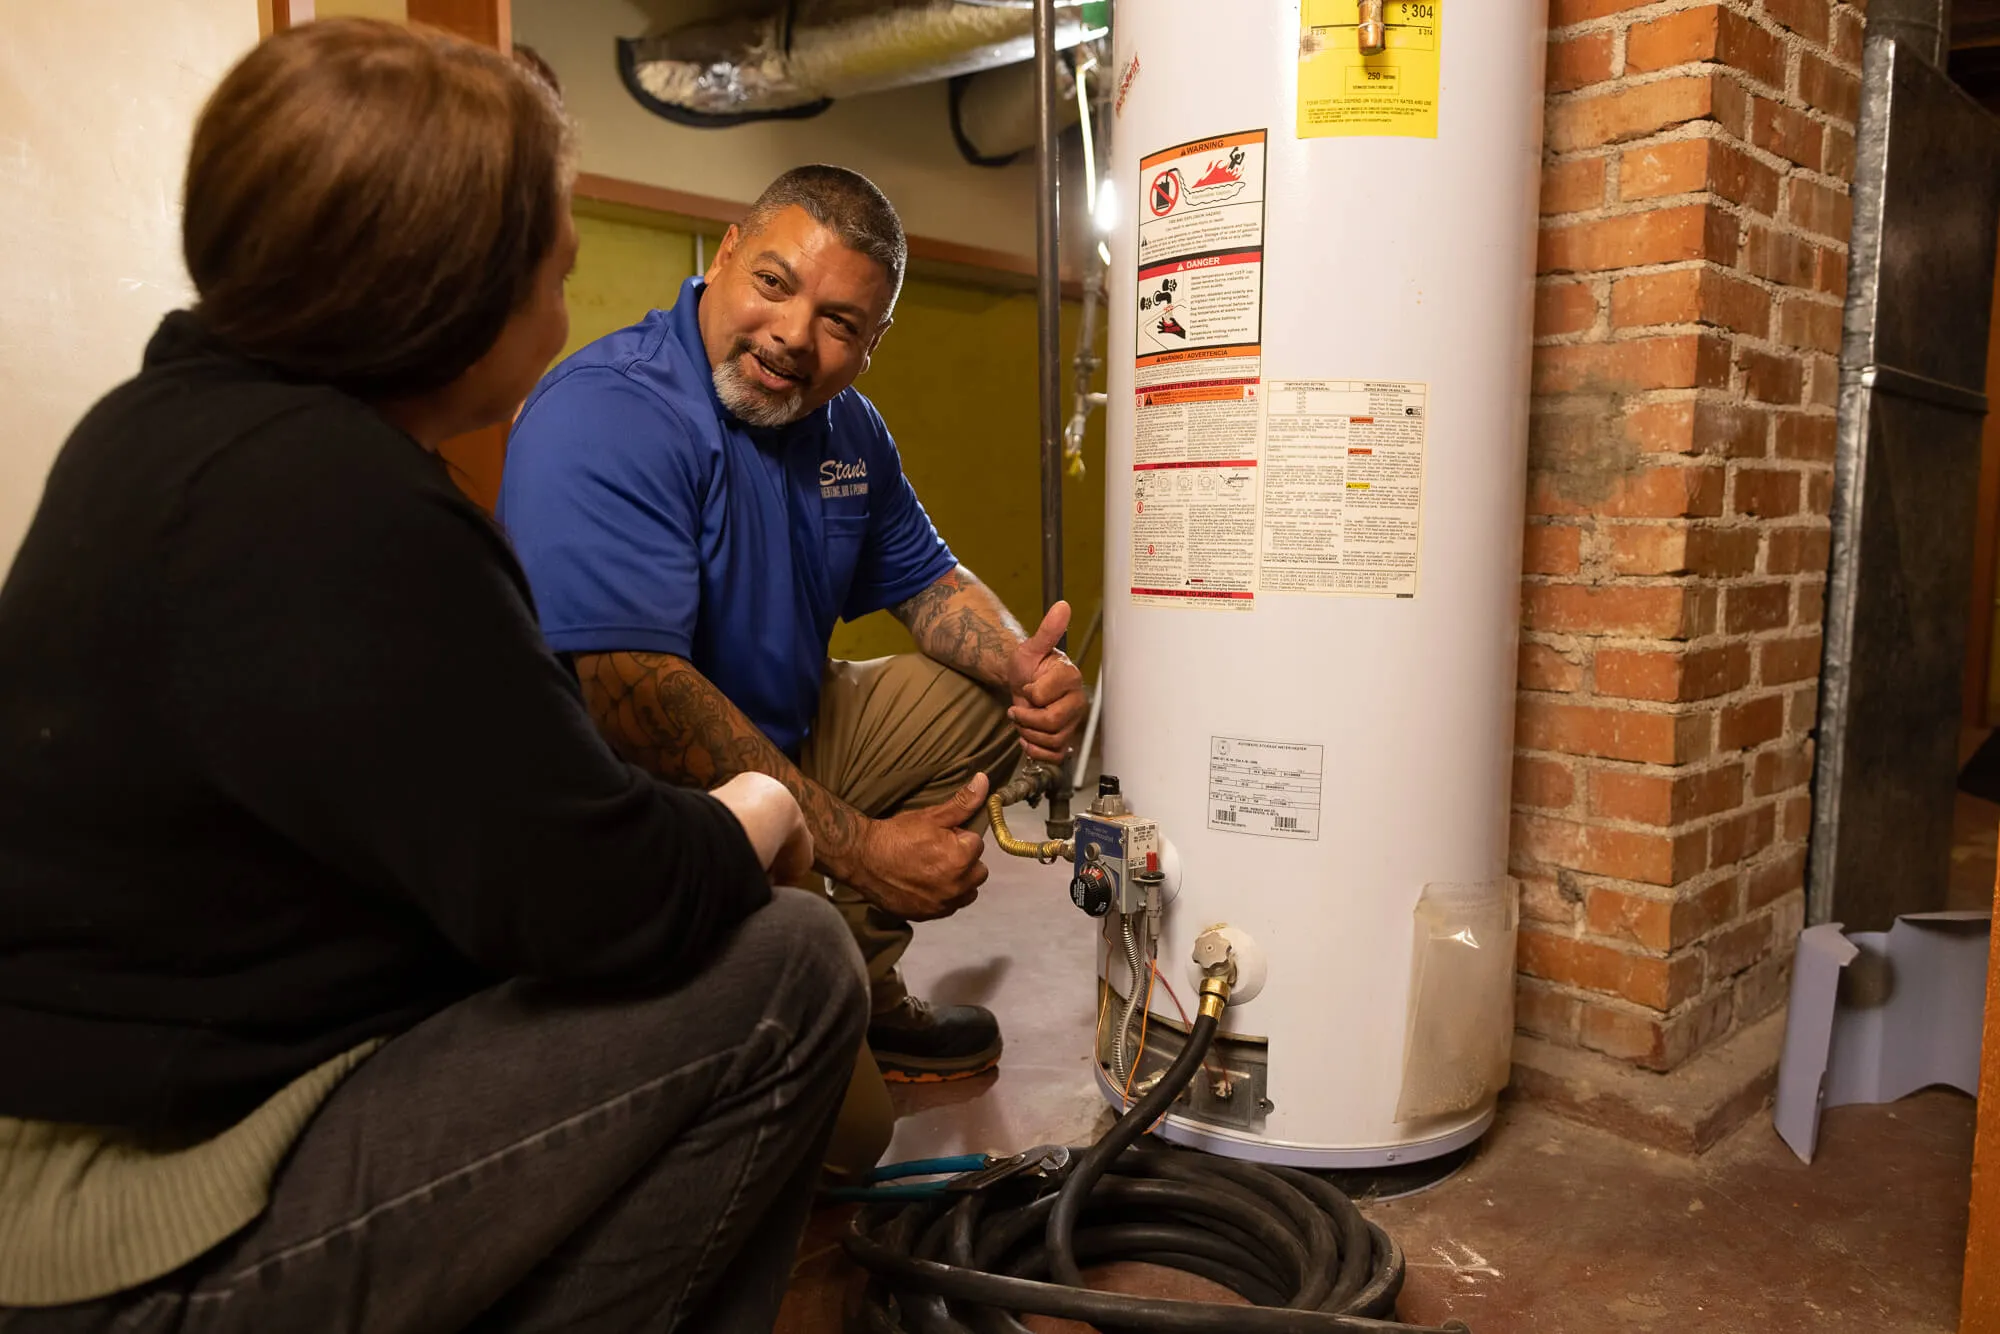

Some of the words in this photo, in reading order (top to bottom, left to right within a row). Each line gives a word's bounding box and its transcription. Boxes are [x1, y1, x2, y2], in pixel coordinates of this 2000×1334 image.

[1401, 3, 1408, 14] $
[1411, 3, 1433, 18] 304
[1367, 72, 1381, 80] 250
[1186, 138, 1224, 155] WARNING
[1186, 257, 1220, 268] DANGER
[1188, 350, 1228, 358] ADVERTENCIA
[820, 458, 868, 486] Stan's
